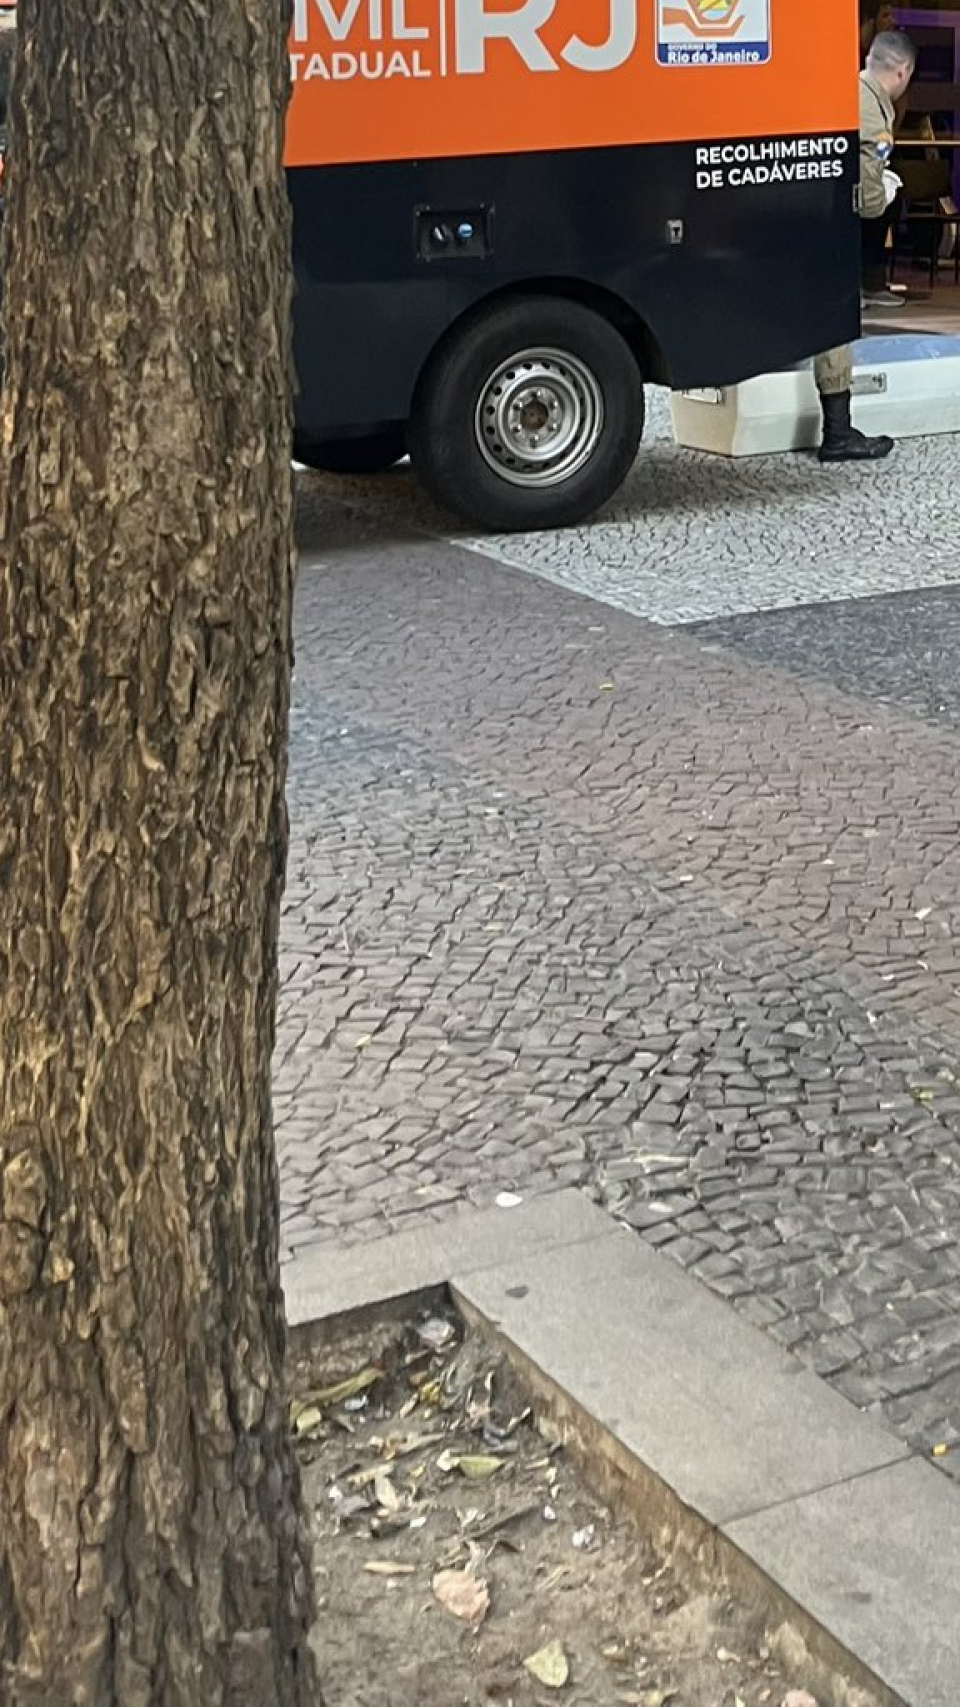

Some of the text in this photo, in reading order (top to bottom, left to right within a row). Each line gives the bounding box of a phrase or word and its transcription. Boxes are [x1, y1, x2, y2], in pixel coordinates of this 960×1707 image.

[667, 49, 761, 64] Rio de Janeiro
[696, 137, 848, 165] RECOLHIMENTO
[696, 159, 844, 189] DE CADÁVERES
